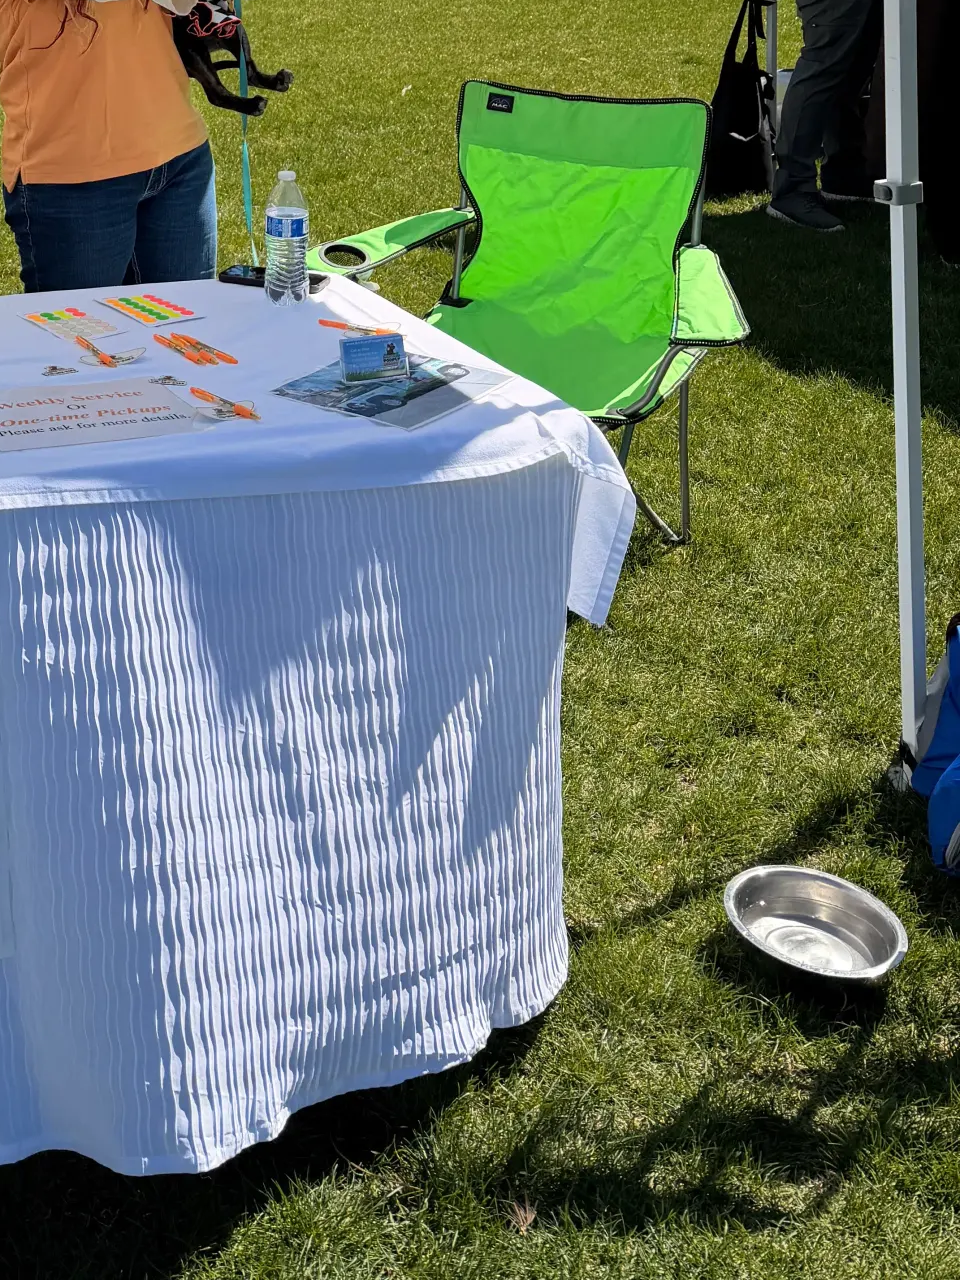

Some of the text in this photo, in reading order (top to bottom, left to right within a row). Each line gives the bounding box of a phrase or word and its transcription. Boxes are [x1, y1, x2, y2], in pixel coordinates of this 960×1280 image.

[70, 389, 144, 402] Service
[66, 403, 88, 411] Or
[0, 412, 90, 427] One-time
[97, 404, 171, 417] Pickups
[48, 423, 74, 432] ask
[76, 420, 98, 429] for
[101, 417, 138, 426] more
[141, 413, 191, 424] details.
